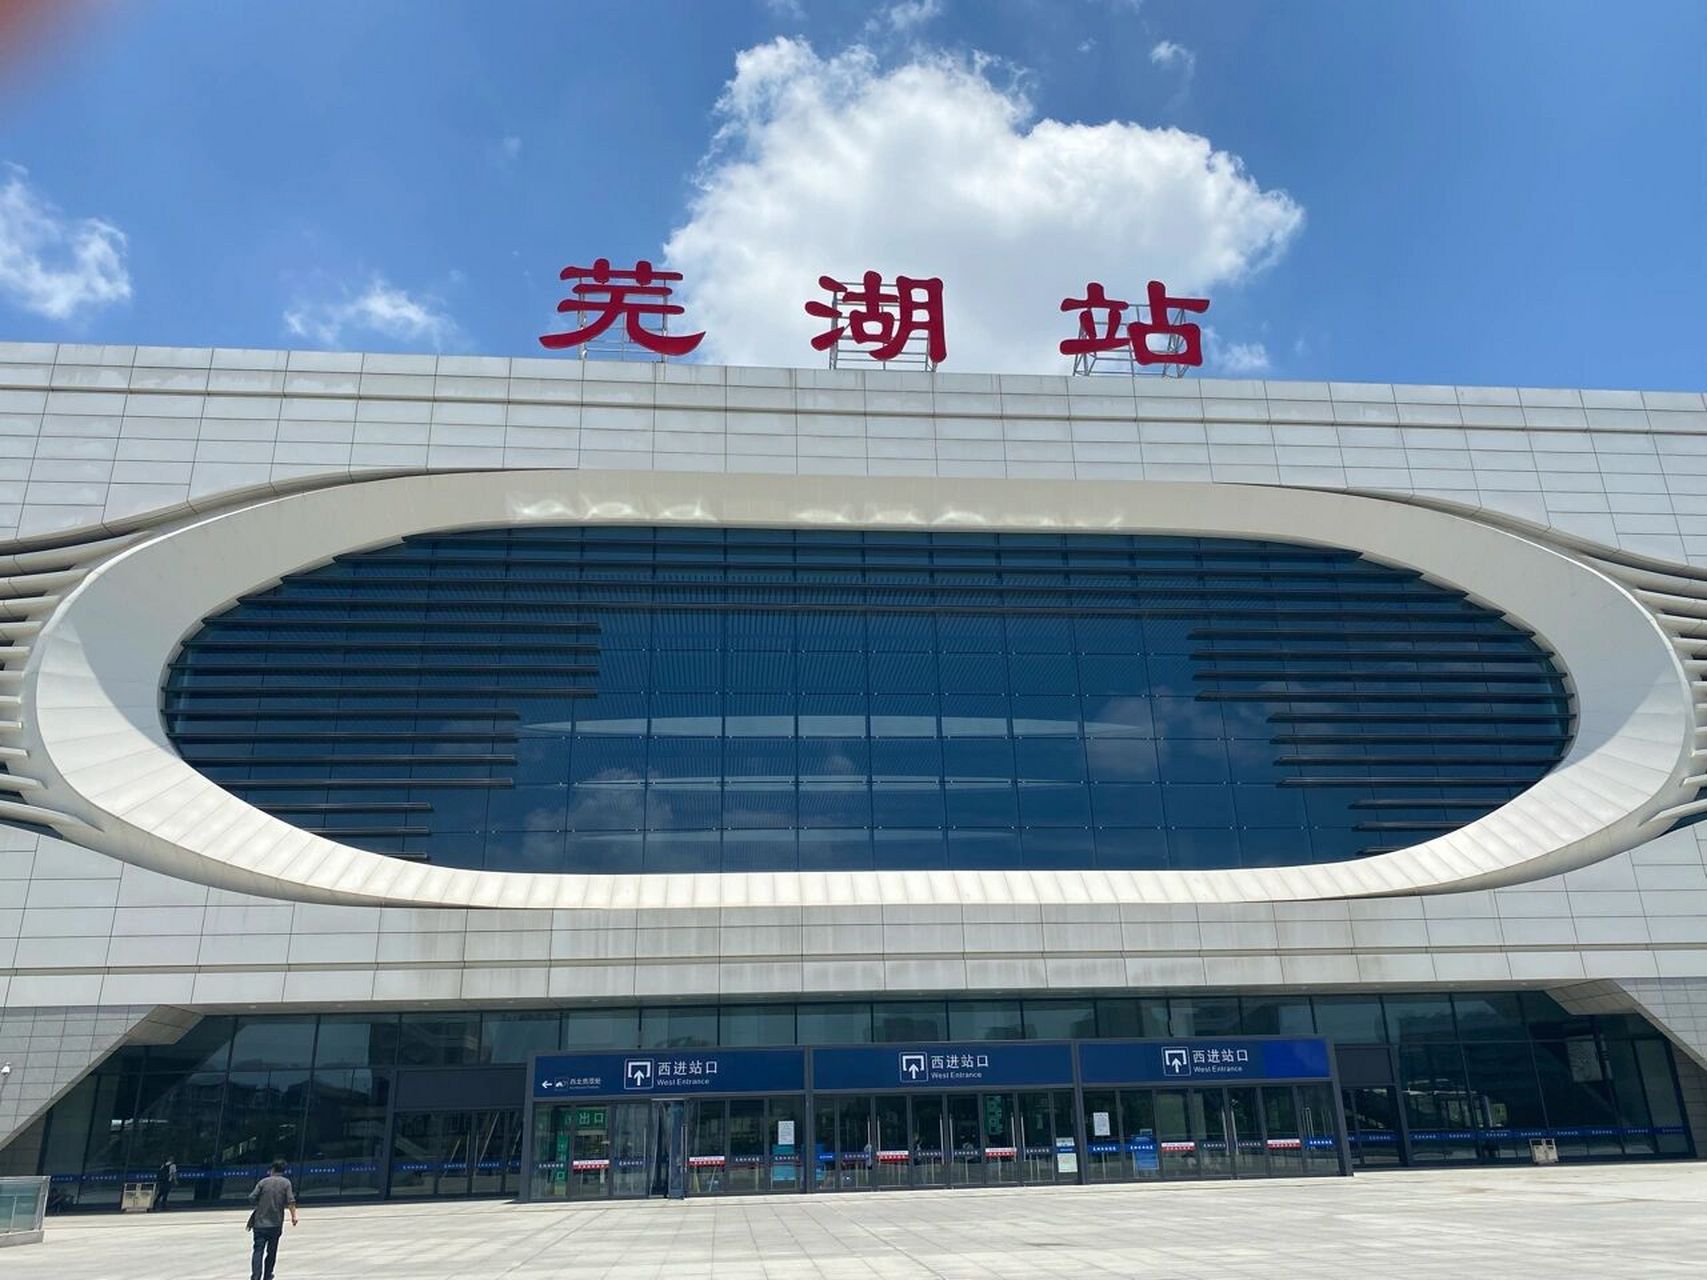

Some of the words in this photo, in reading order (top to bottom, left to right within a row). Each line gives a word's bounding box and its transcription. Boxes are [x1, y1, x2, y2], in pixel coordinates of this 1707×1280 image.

[539, 258, 1210, 366] 芜湖站
[931, 1054, 989, 1069] 西进站口
[1192, 1049, 1248, 1063] 西进站口
[658, 1060, 718, 1075] 西进站口
[1212, 1064, 1243, 1073] Entrance
[931, 1071, 949, 1079] West
[951, 1071, 982, 1079] Entrance
[656, 1079, 676, 1087] West
[677, 1078, 710, 1086] Entrance
